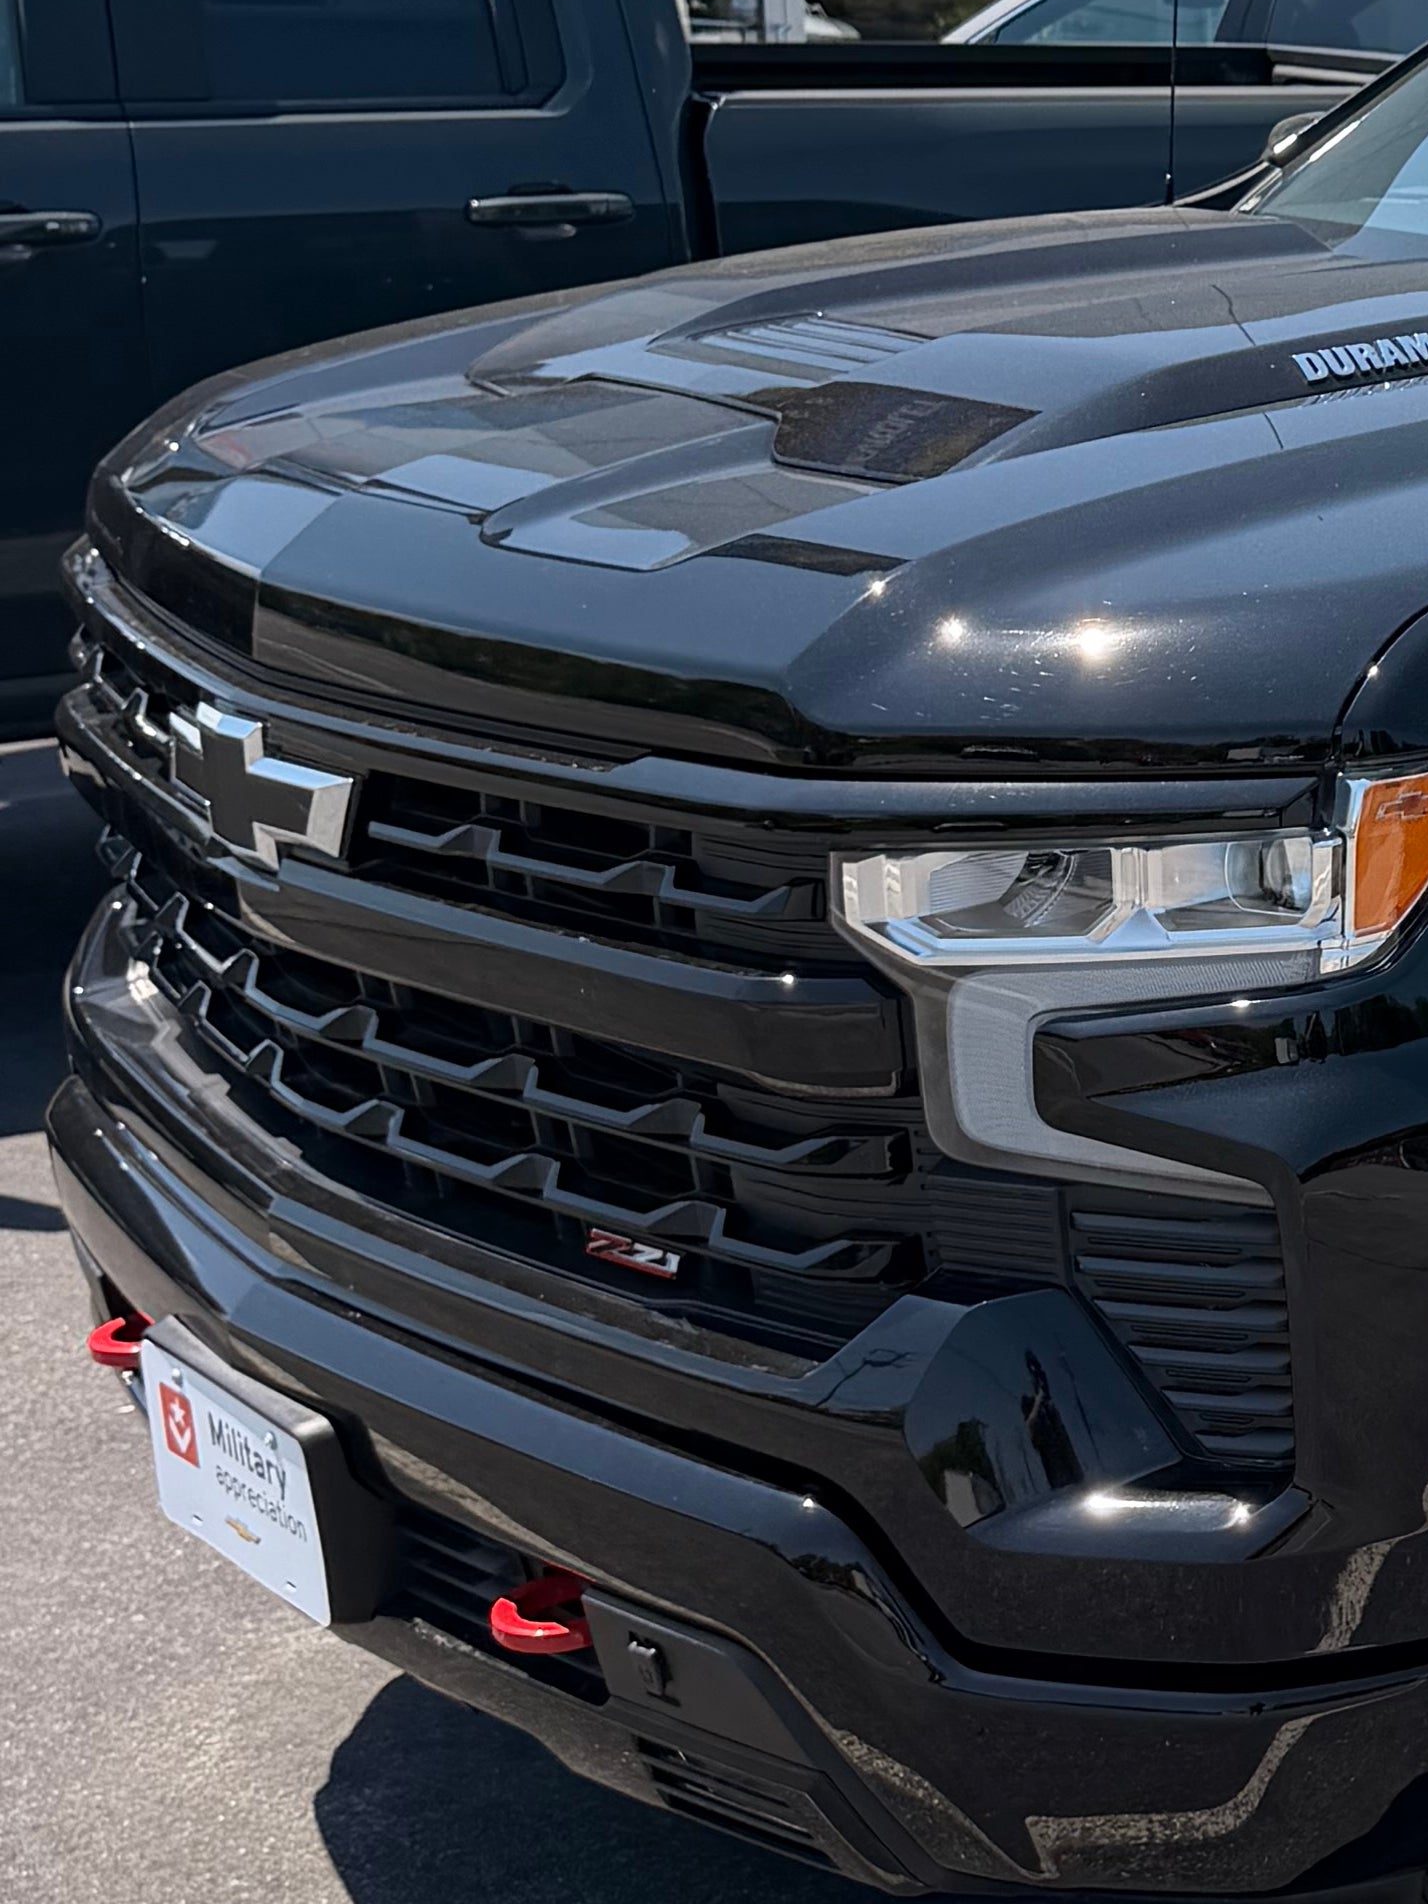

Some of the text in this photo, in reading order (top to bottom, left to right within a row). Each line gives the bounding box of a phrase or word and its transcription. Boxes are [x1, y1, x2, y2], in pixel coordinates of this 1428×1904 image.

[586, 1227, 681, 1280] Z71
[207, 1410, 287, 1501] Military
[215, 1463, 308, 1543] appreciation
